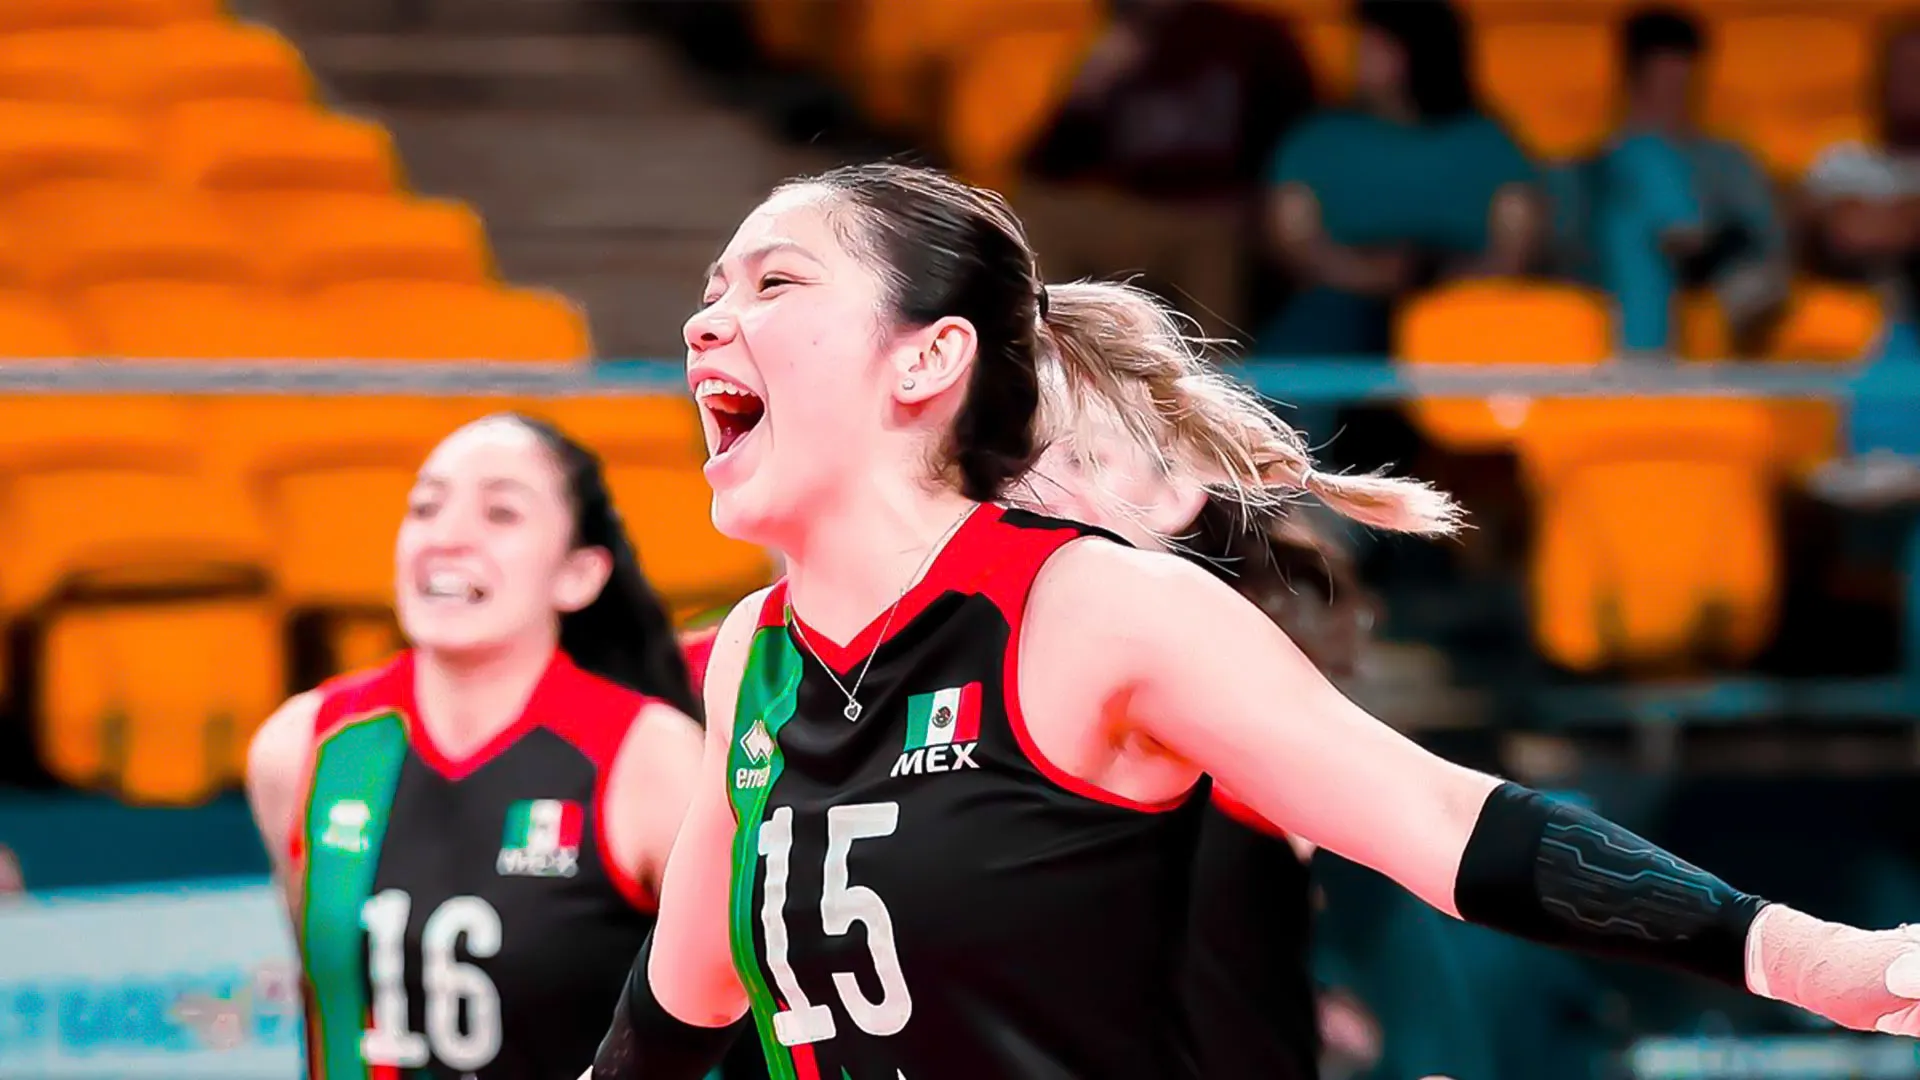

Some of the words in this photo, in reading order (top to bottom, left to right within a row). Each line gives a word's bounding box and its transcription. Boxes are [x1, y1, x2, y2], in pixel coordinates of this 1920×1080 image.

[890, 742, 980, 778] MEX
[360, 888, 503, 1072] 16
[758, 801, 912, 1046] 15
